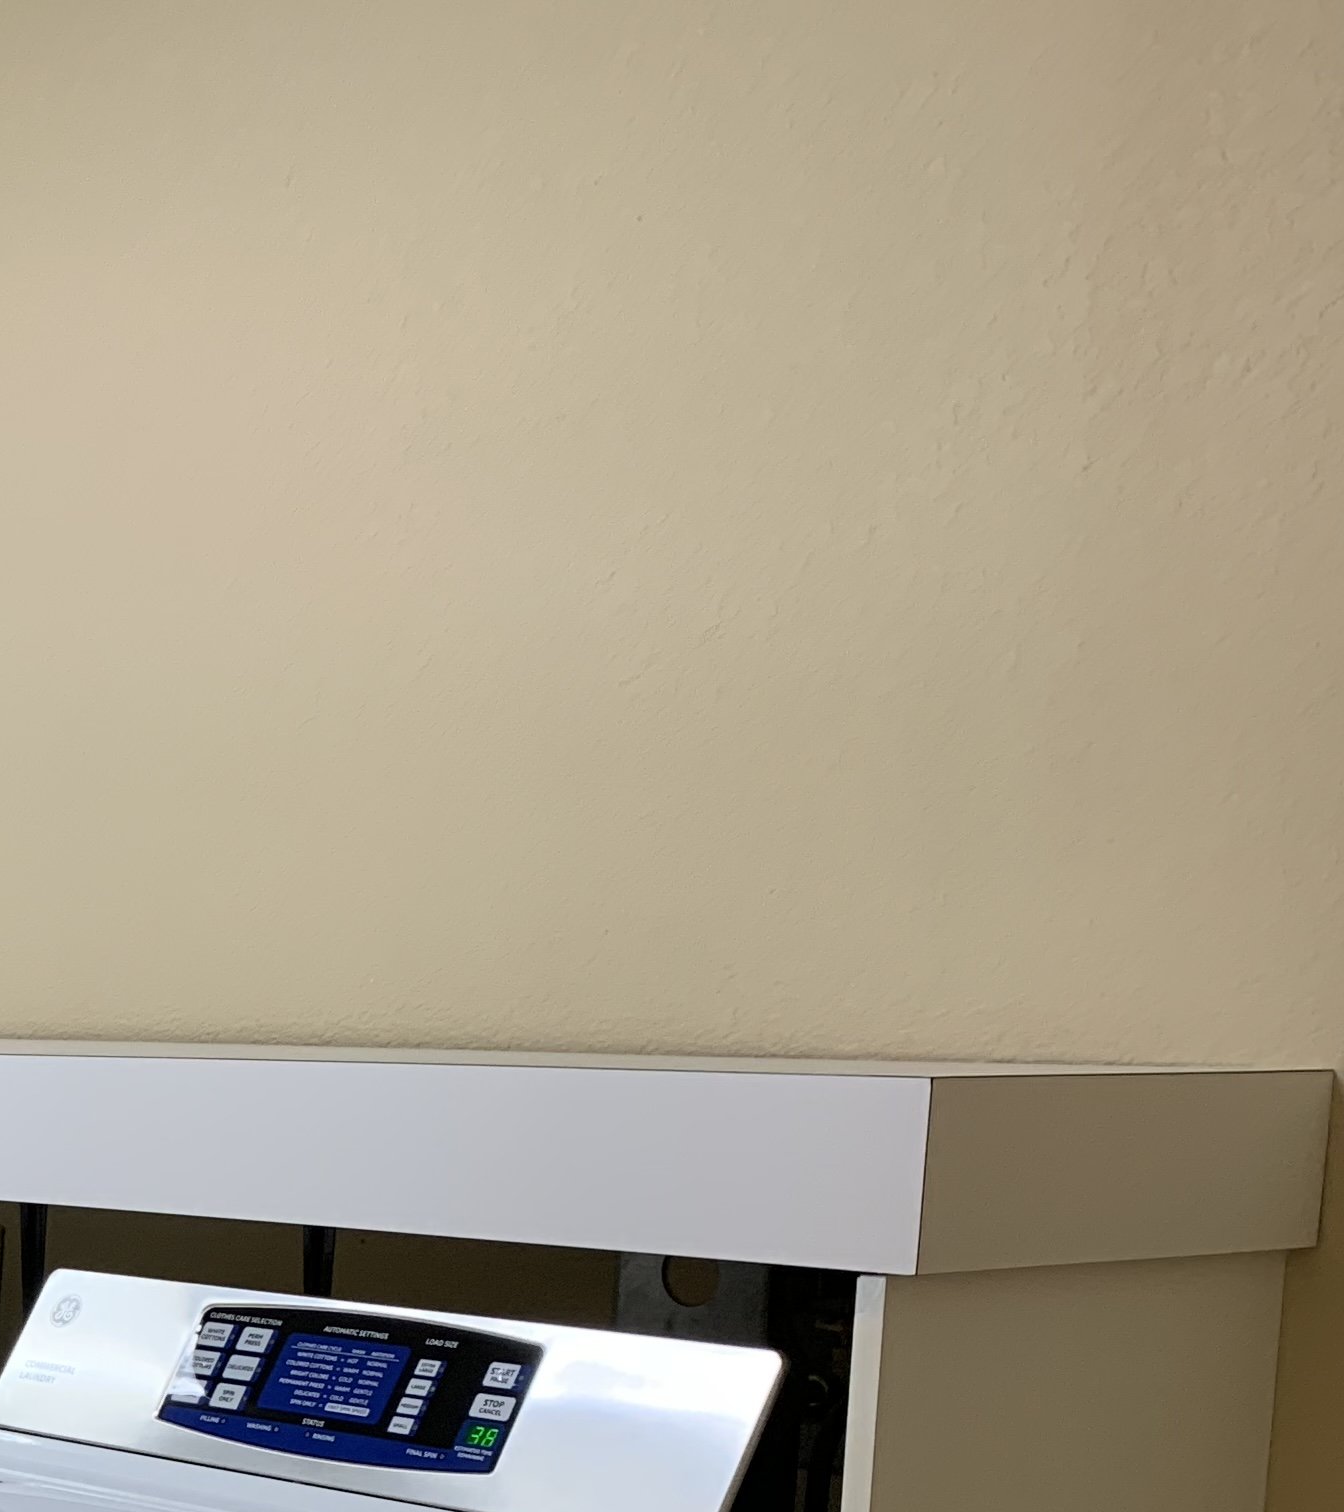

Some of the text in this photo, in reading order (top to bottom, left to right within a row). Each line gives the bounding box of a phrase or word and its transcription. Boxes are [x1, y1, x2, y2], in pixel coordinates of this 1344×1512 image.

[210, 1312, 283, 1326] CLOTHES CARE SELECTION
[323, 1326, 389, 1339] AUTOMATIC SETTINGS
[425, 1338, 459, 1349] LOAD SIZE
[490, 1367, 516, 1376] START
[483, 1399, 505, 1408] STOP
[479, 1407, 502, 1417] CANCEL
[200, 1414, 220, 1424] FILLING
[302, 1418, 325, 1427] STATUS
[246, 1422, 272, 1432] WASHING
[467, 1426, 499, 1448] 38
[406, 1448, 438, 1459] FINAL SPIN
